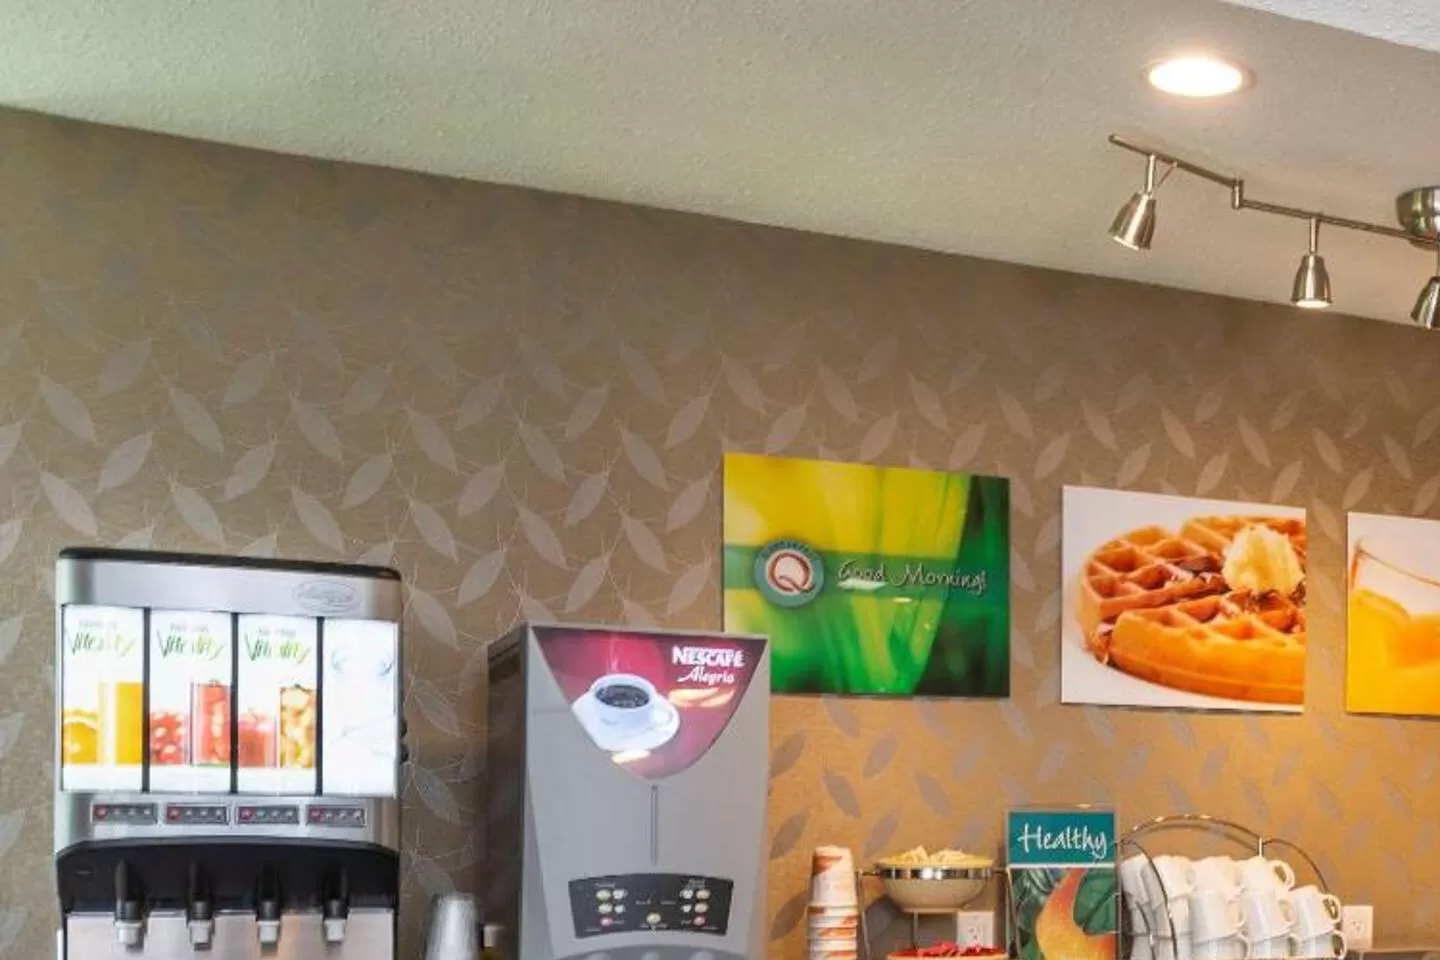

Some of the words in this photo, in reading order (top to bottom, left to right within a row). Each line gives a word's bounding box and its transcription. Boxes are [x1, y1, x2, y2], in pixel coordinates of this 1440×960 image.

[767, 552, 816, 593] Q
[838, 559, 885, 581] Good
[890, 562, 987, 596] Morning!
[677, 665, 735, 685] Alegria
[1017, 823, 1107, 861] Healthy
